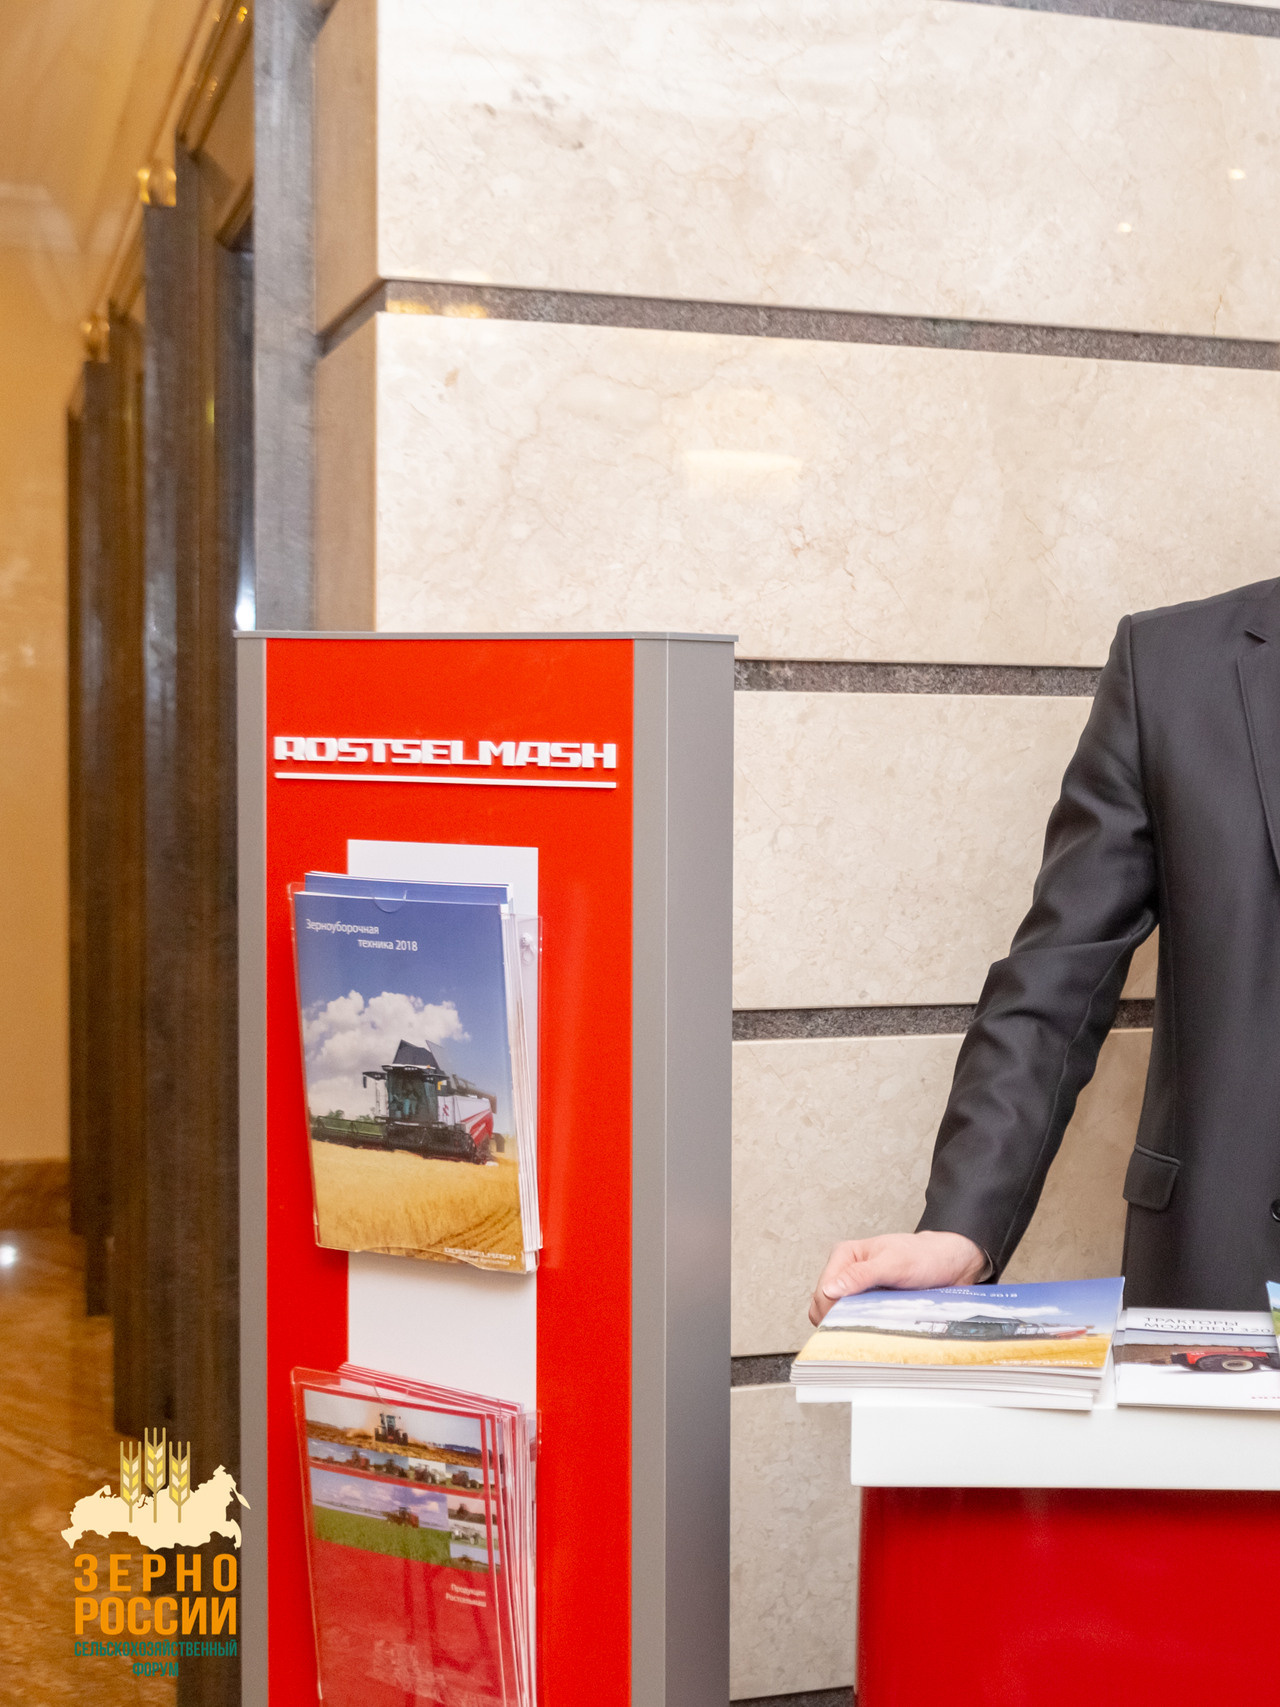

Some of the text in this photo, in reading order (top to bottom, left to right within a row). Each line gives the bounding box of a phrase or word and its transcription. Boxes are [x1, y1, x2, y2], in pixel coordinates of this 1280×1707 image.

[274, 736, 616, 768] ROSTSELMASH
[305, 918, 379, 935] Зерноуборочная
[357, 939, 418, 952] техника 2018
[1144, 1316, 1239, 1327] ТРАКТОРЫ
